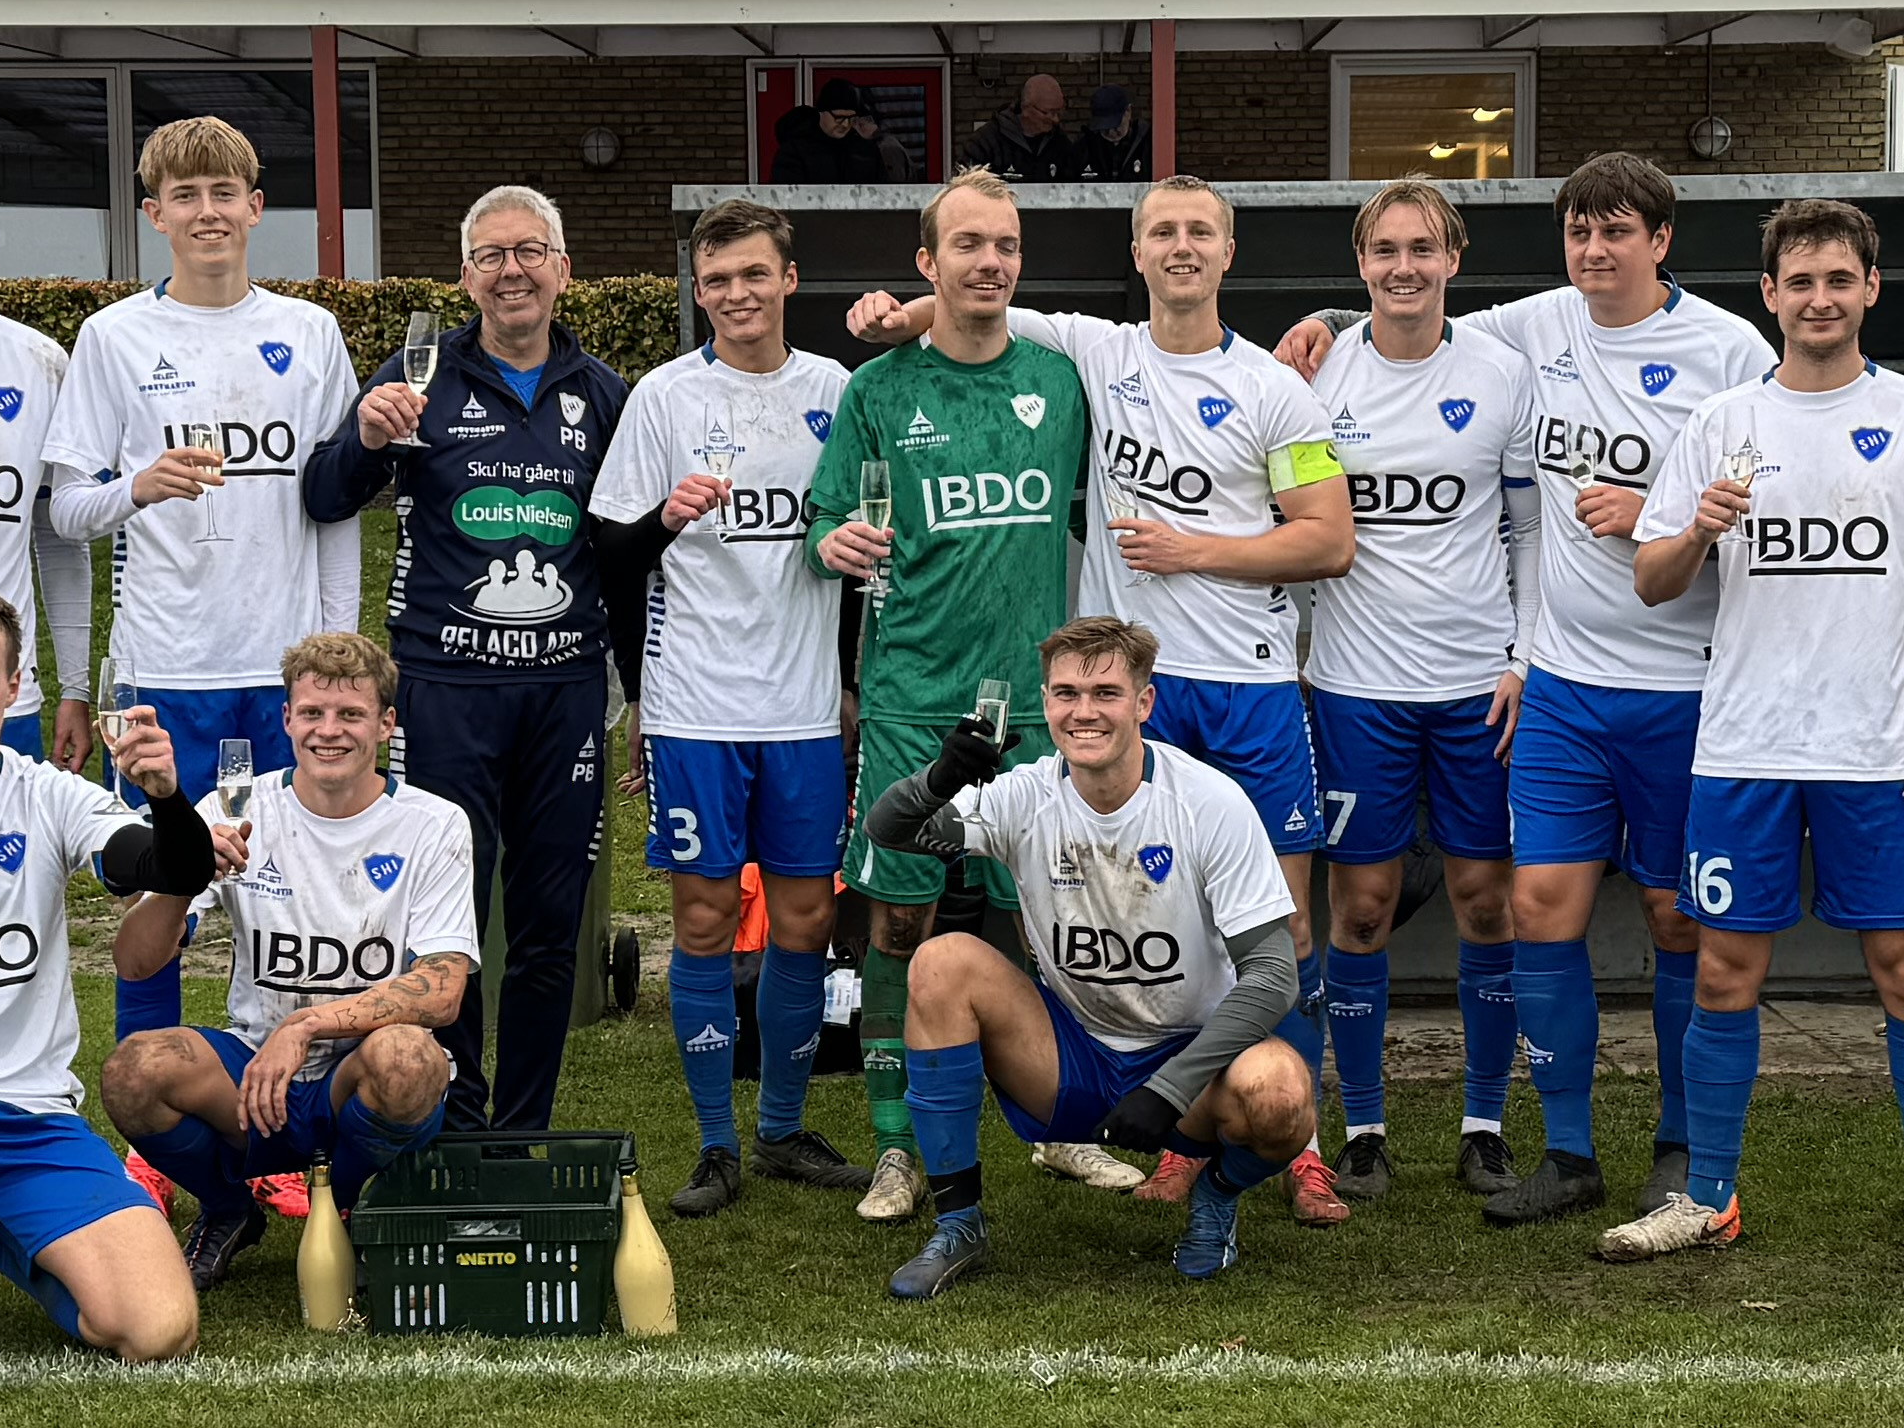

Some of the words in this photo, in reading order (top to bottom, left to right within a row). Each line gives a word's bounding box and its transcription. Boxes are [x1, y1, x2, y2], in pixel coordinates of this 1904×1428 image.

[267, 347, 289, 364] SHI
[1645, 370, 1669, 386] SHI
[1020, 400, 1040, 417] SHI
[1202, 403, 1227, 417] SHI
[1446, 403, 1469, 421] SHI
[811, 414, 829, 432] SHI
[560, 426, 586, 451] PB
[1858, 432, 1885, 450] SHI
[525, 463, 559, 483] gået
[563, 469, 574, 485] til
[938, 468, 1052, 517] BDO
[1346, 474, 1466, 514] BDO
[462, 503, 513, 521] Louis
[517, 505, 572, 529] Nielsen
[1758, 516, 1889, 562] BDO
[572, 763, 594, 782] PB
[1319, 791, 1356, 845] 7
[372, 859, 398, 879] SHI
[1146, 850, 1170, 871] SHI
[1689, 852, 1733, 915] 16
[268, 932, 395, 981] BDO
[1066, 926, 1180, 973] BDO
[465, 1252, 516, 1265] NETTO
